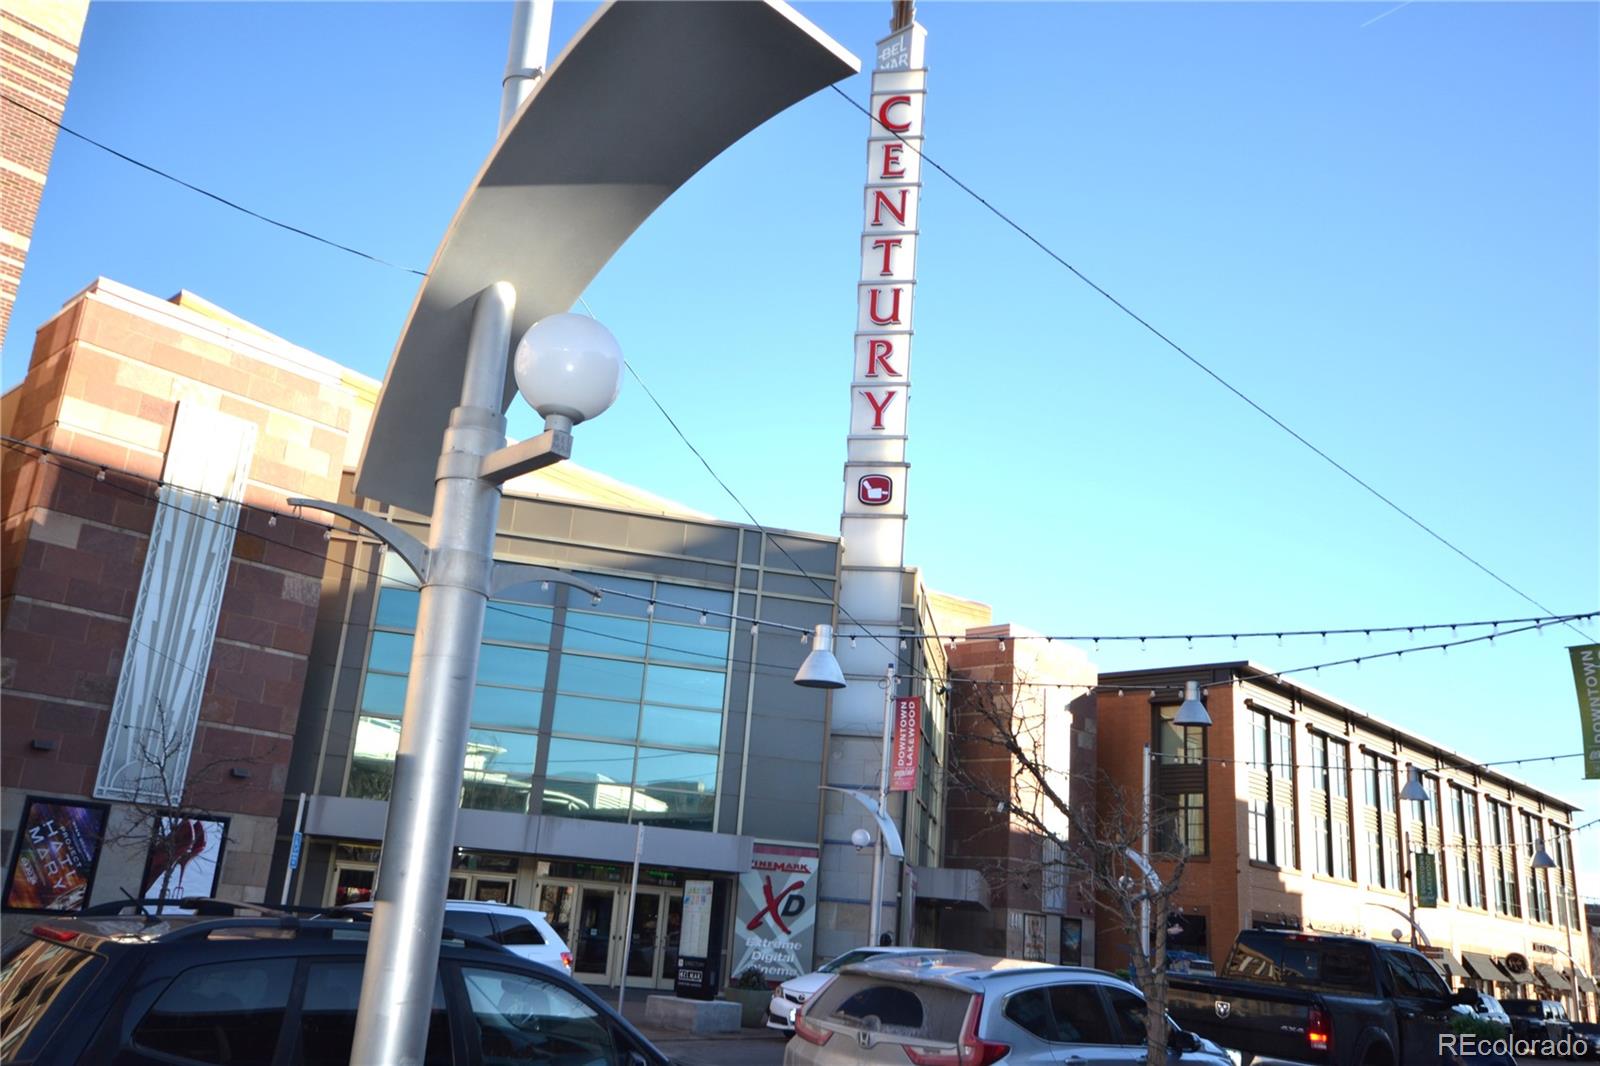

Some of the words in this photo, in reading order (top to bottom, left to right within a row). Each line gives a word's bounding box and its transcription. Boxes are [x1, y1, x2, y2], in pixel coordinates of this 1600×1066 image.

[863, 95, 912, 431] CENTURY
[1581, 650, 1600, 744] DOWNTOWN
[898, 701, 908, 767] DOWNTOWN
[906, 701, 916, 767] LAKEWOOD
[29, 826, 67, 889] MARY
[46, 820, 76, 885] HAIL
[60, 825, 82, 868] PROJECT
[746, 874, 806, 935] XD
[751, 951, 795, 964] Digital
